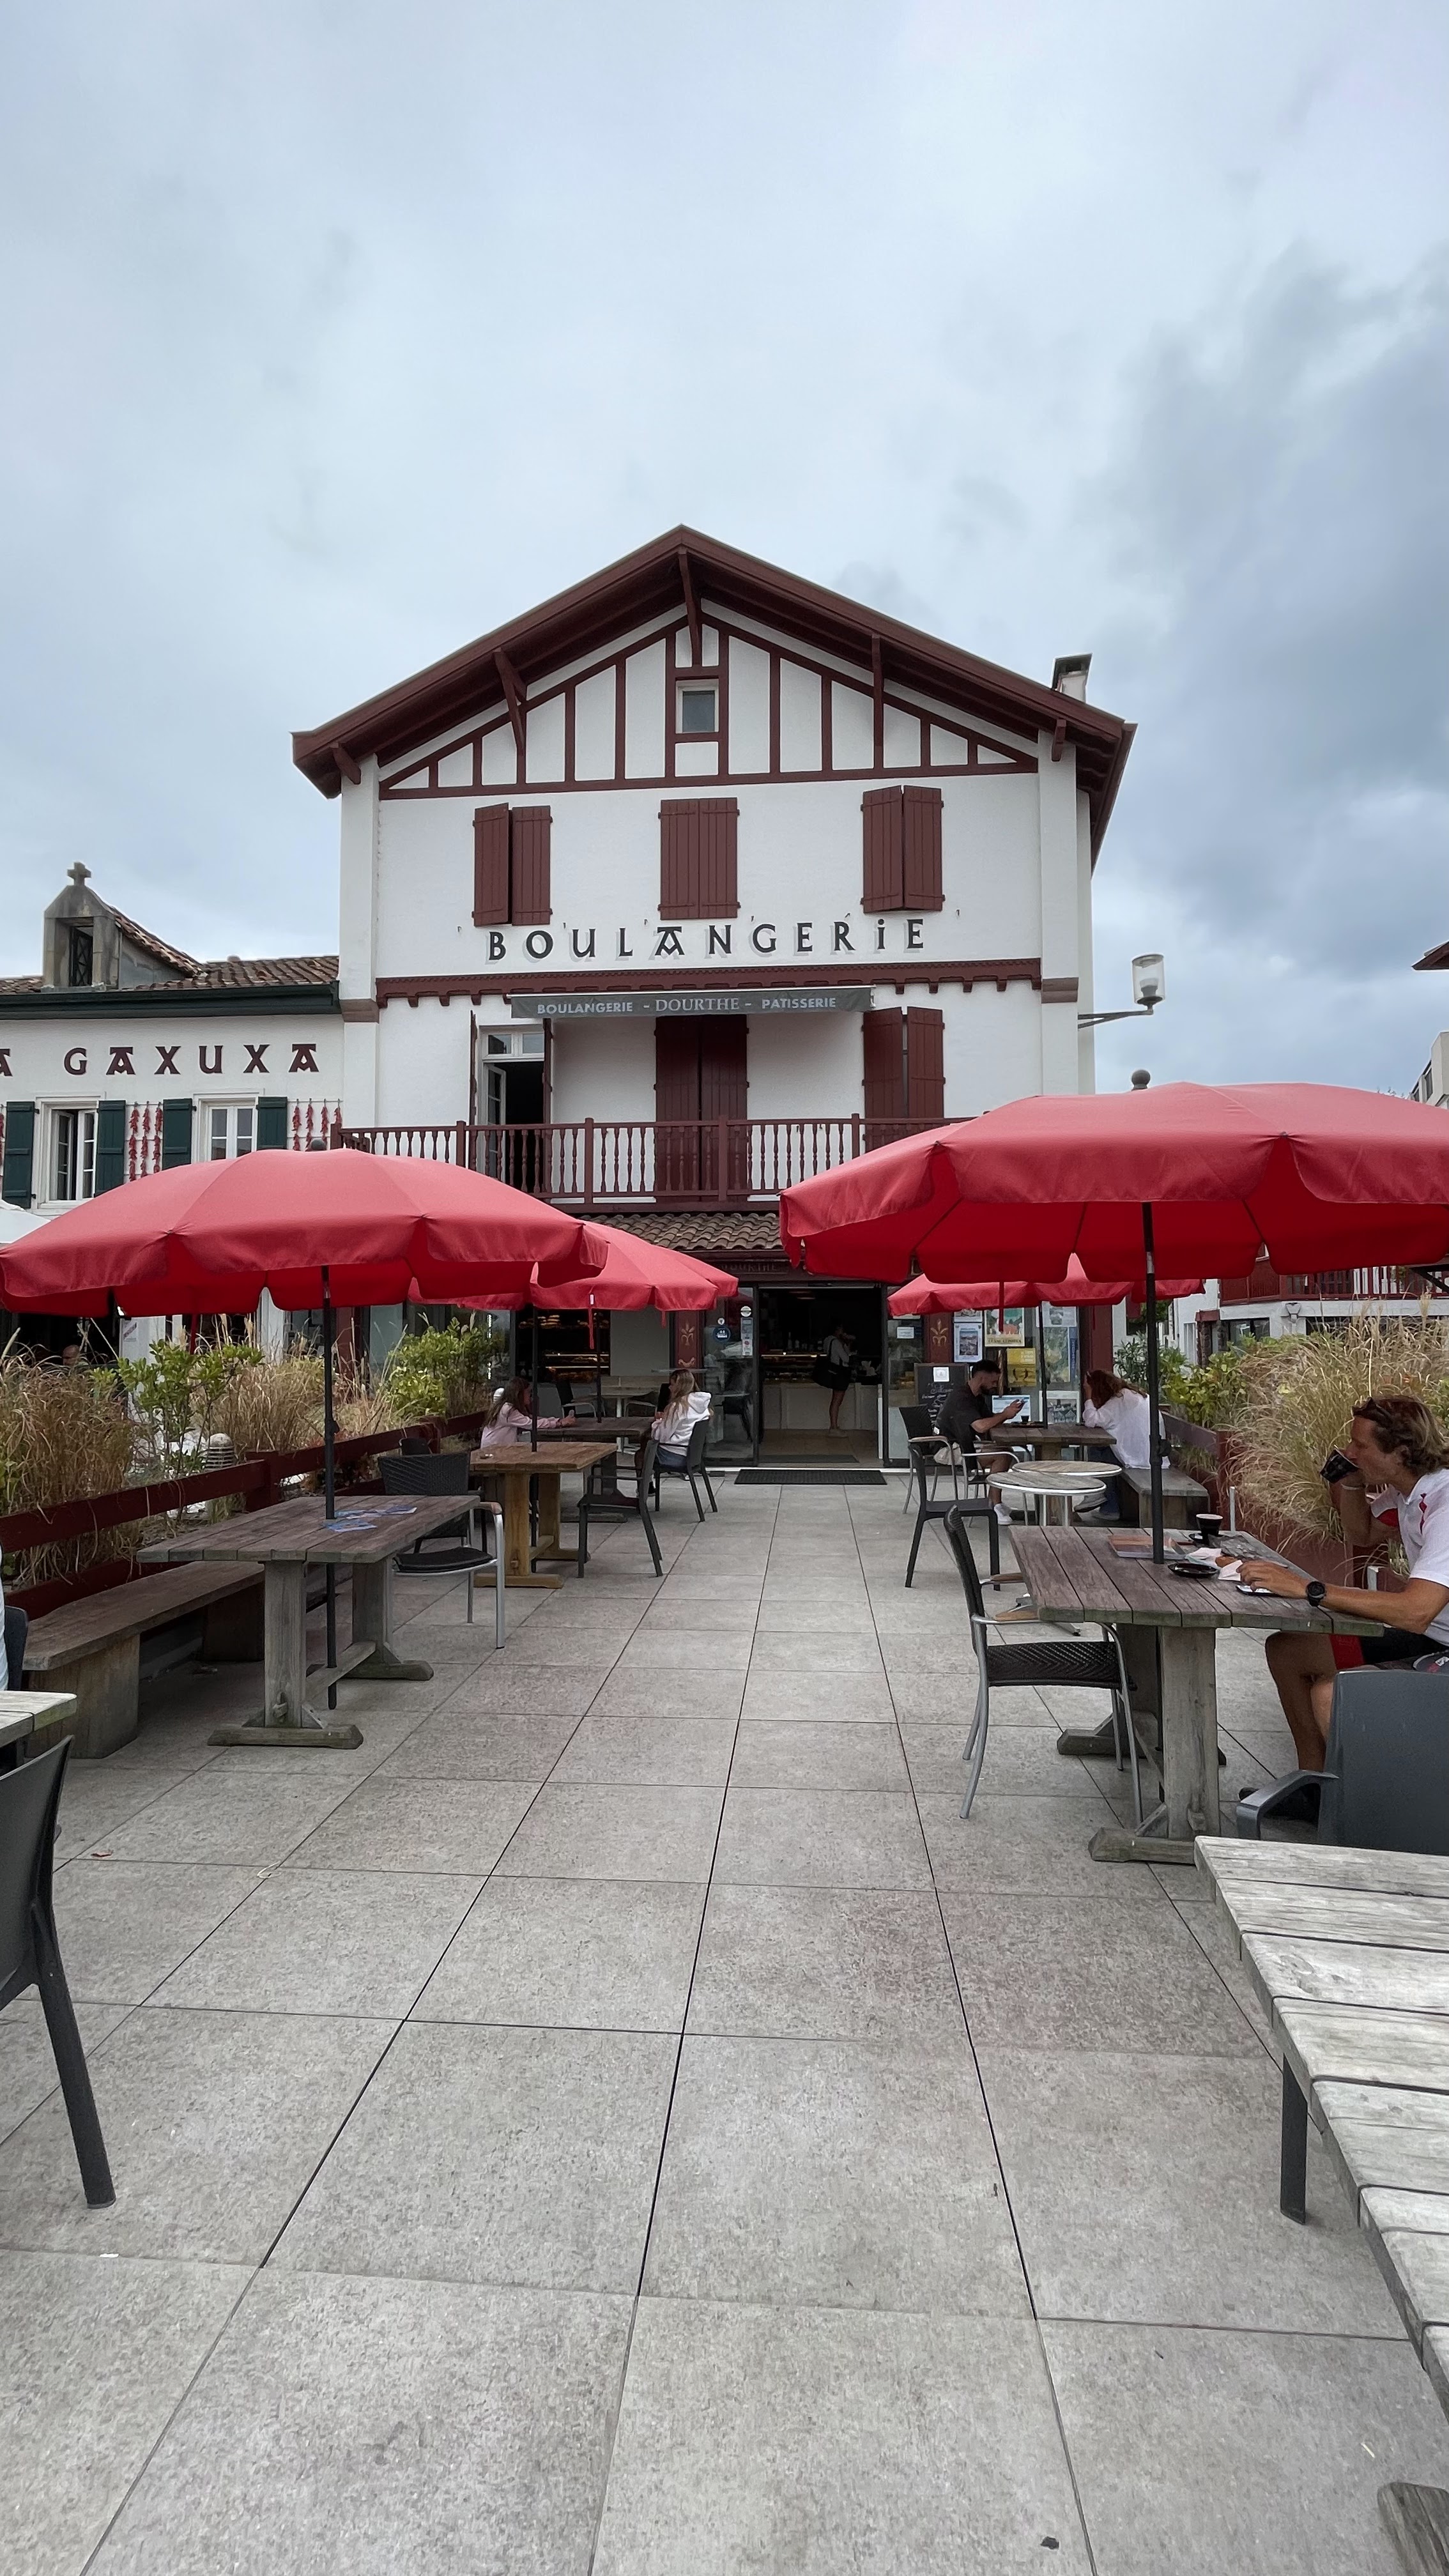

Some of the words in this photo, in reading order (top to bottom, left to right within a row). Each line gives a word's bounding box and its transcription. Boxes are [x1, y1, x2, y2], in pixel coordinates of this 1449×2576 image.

[537, 1002, 633, 1015] BOULANGERIE
[656, 998, 739, 1012] DOURTHE
[762, 997, 836, 1009] PATISSERIE
[63, 1043, 319, 1076] GAXUXA
